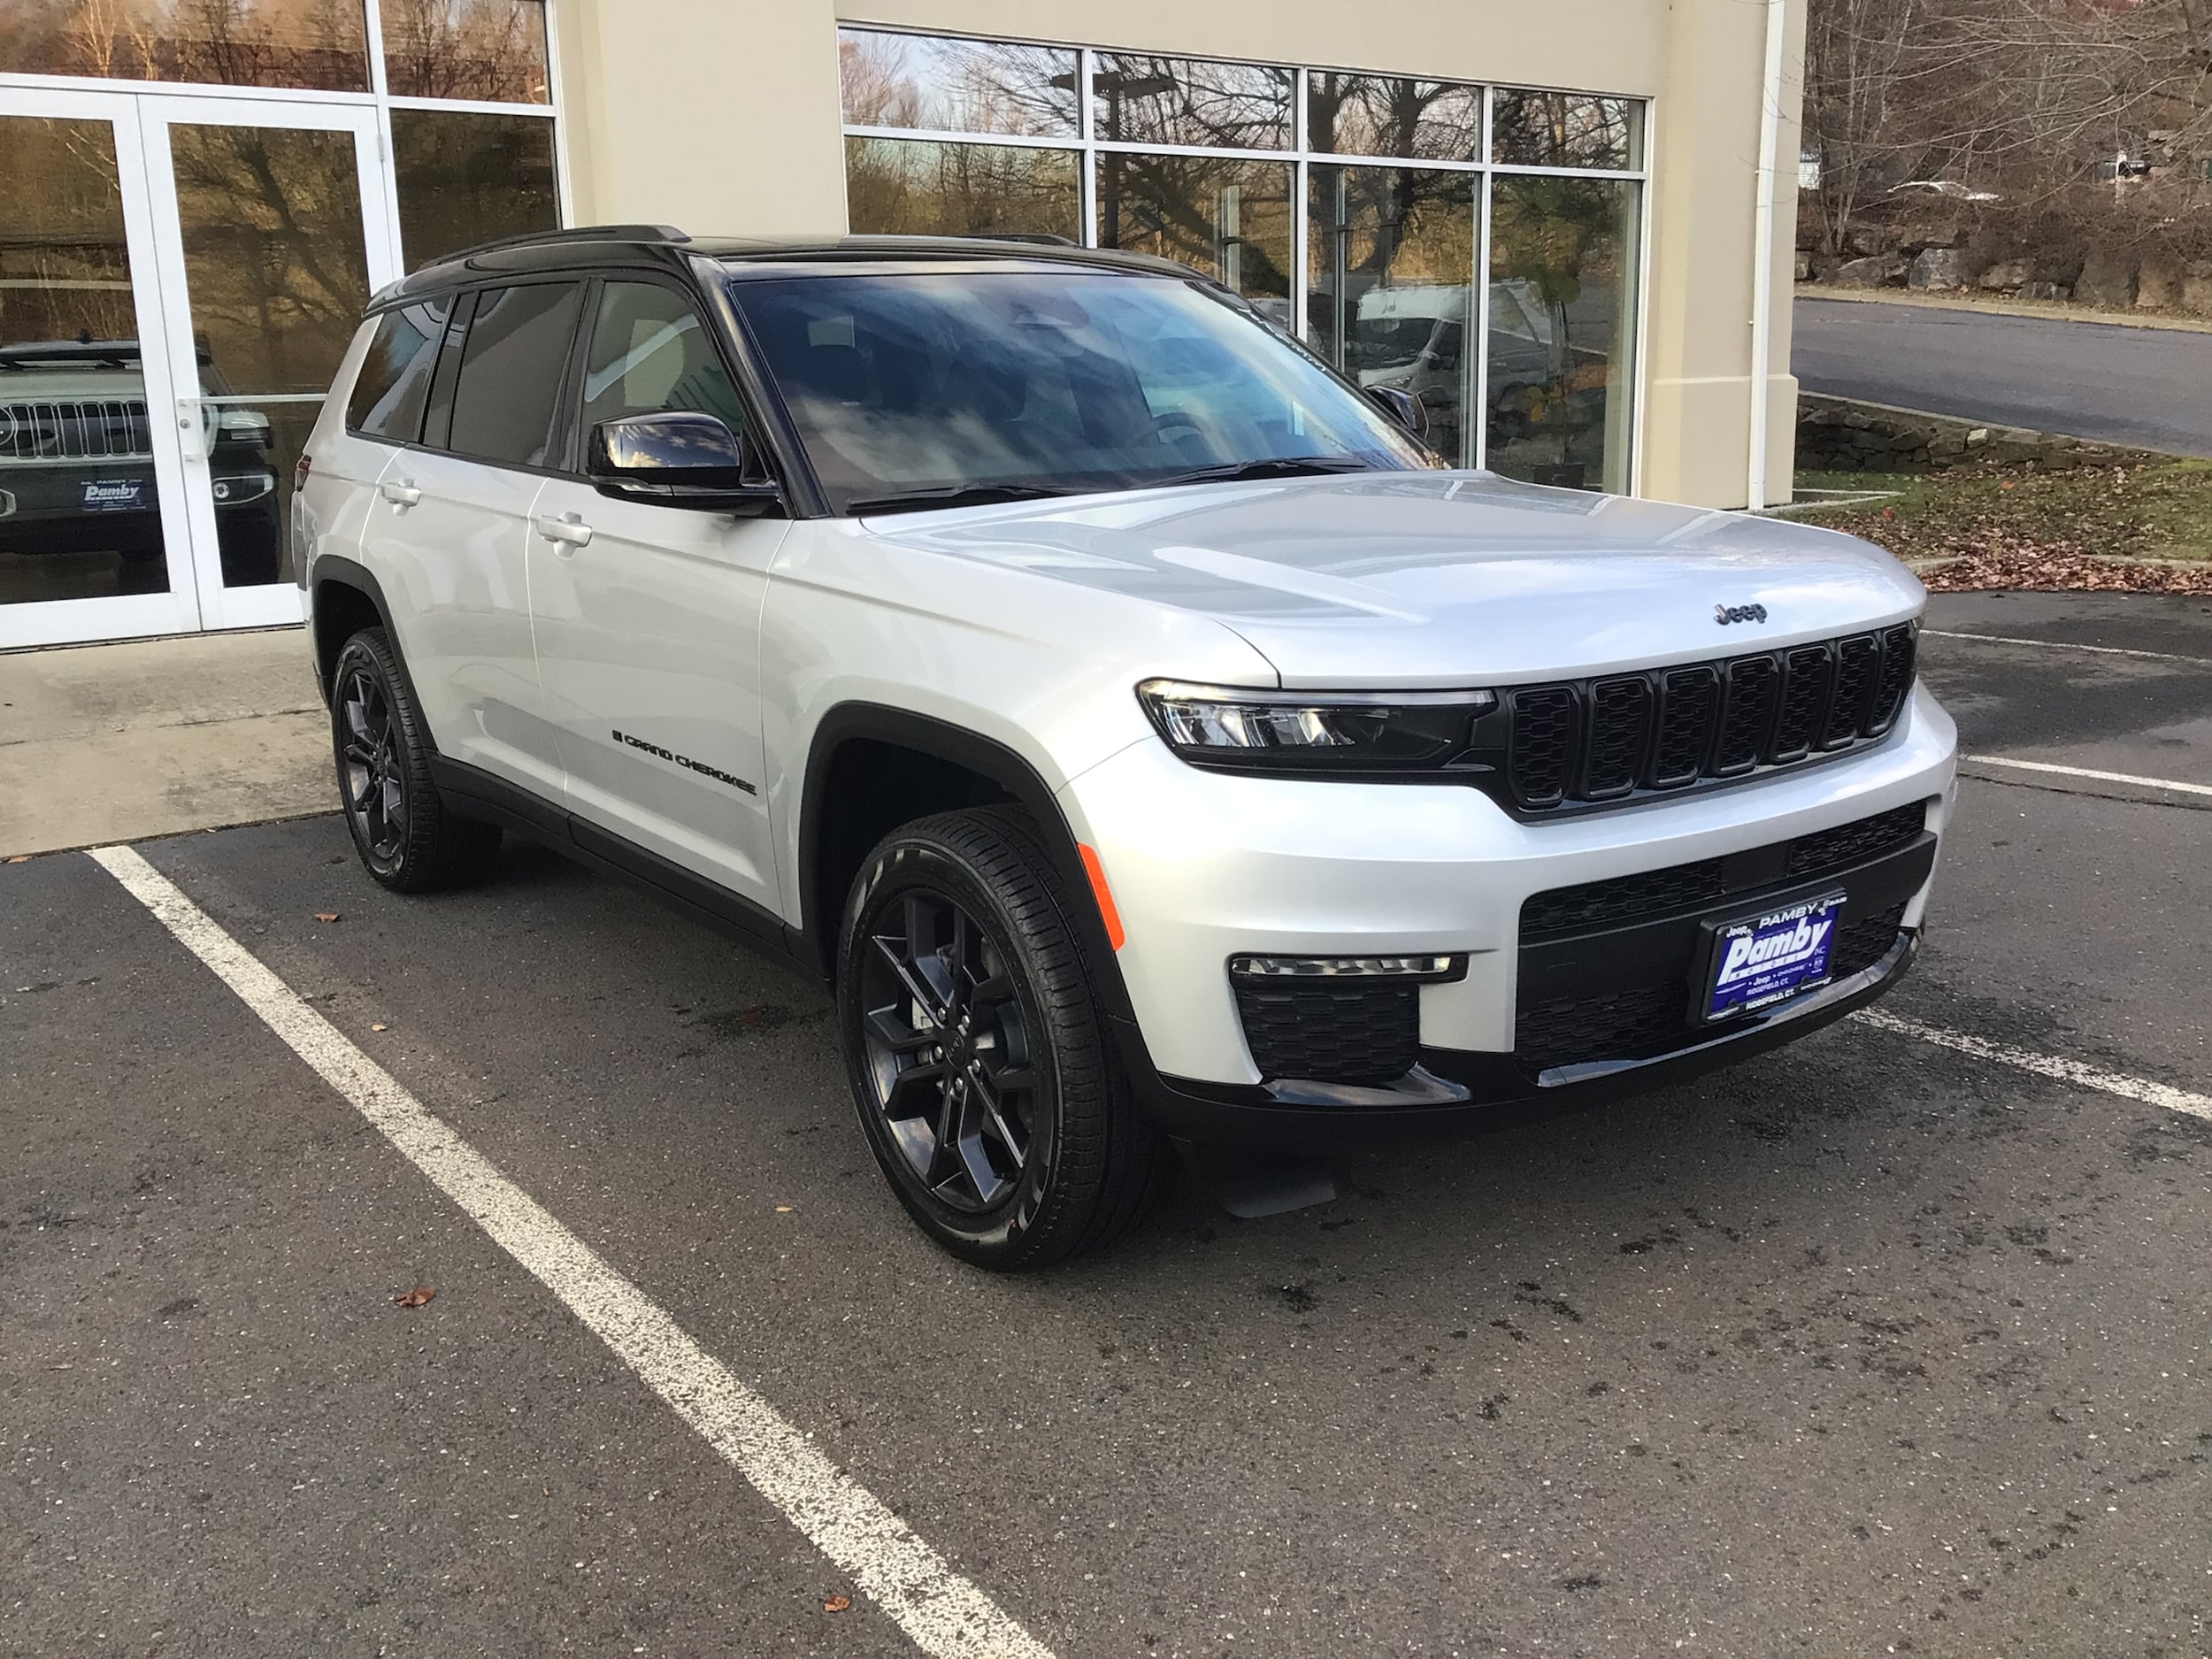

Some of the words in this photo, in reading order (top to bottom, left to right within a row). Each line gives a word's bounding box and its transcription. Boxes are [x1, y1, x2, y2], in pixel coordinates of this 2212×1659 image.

[85, 484, 139, 501] Pamby
[1713, 603, 1768, 626] Jeep
[624, 734, 672, 761] GRAND
[675, 755, 757, 796] CHEROKEE
[1759, 902, 1818, 929] PAMBY
[1716, 916, 1832, 987] Pamby
